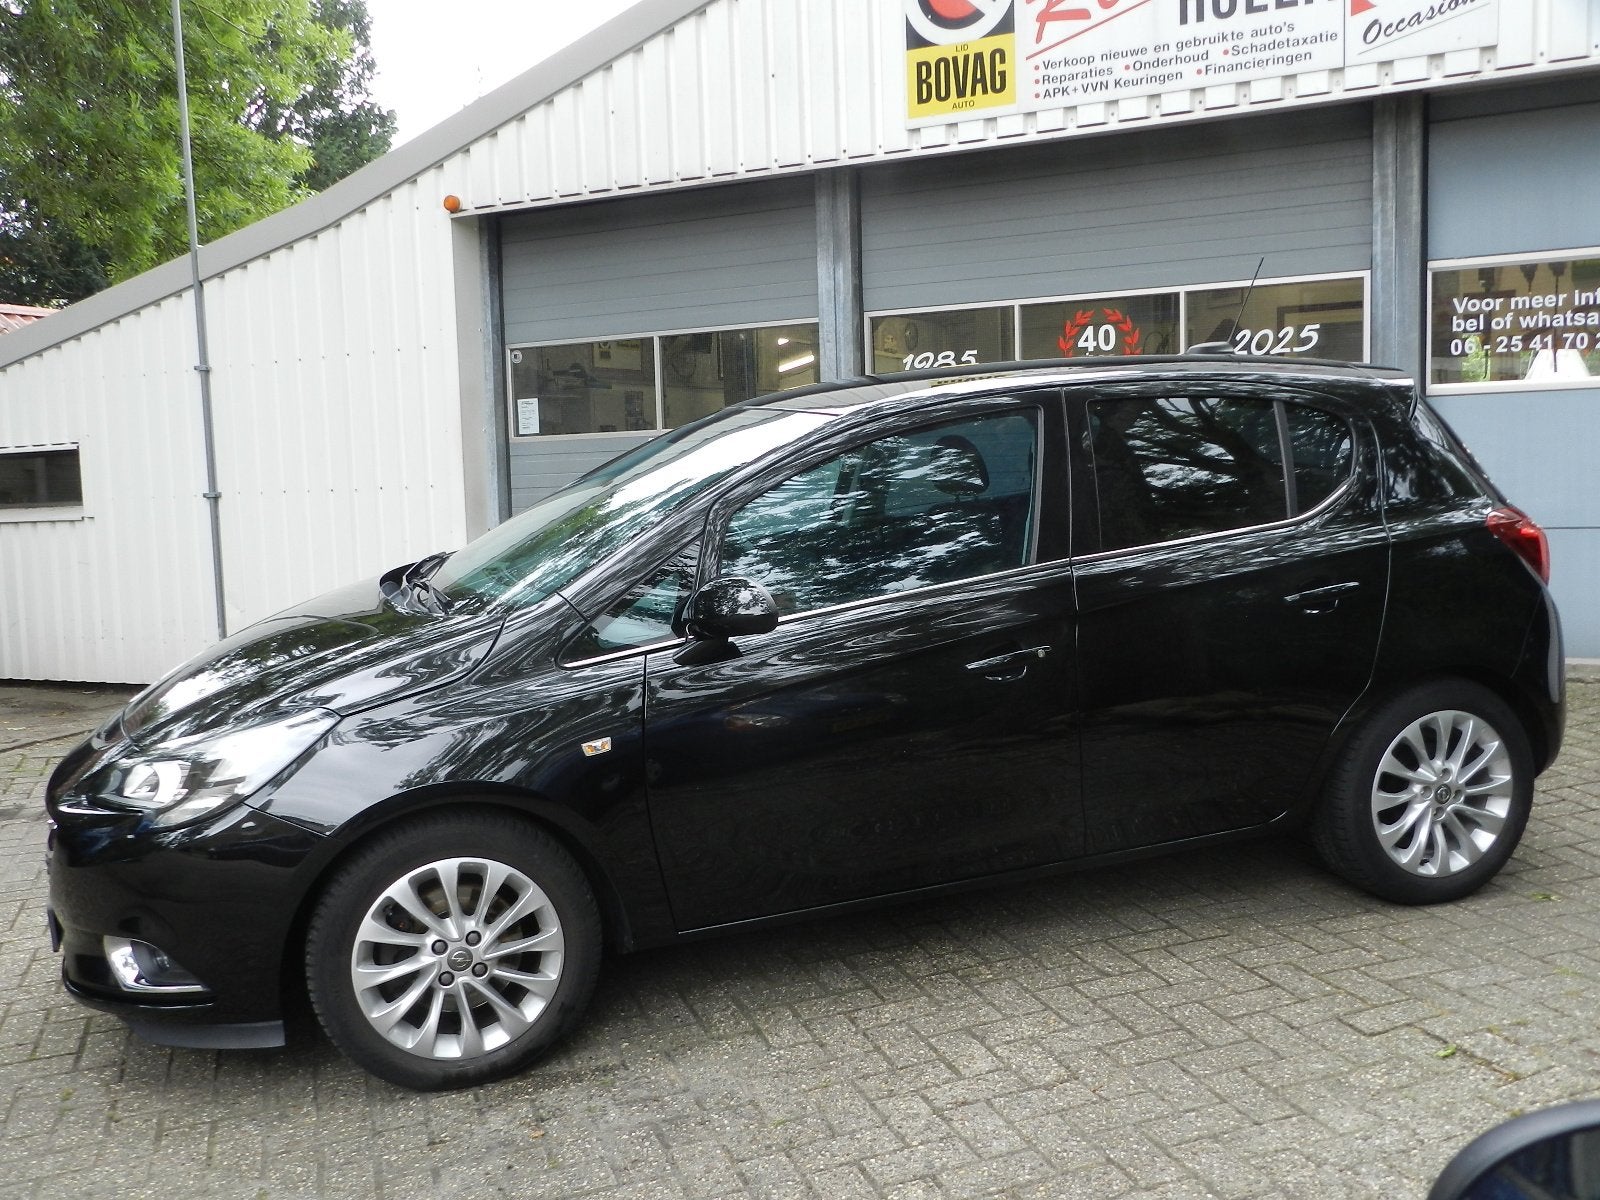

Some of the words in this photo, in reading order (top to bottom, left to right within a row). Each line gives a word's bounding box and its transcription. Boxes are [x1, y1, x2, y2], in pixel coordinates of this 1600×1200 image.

[955, 44, 969, 53] LID
[1042, 66, 1114, 86] Reparaties
[1133, 50, 1209, 71] Onderhoud
[1231, 31, 1338, 56] Schadetaxatie
[1043, 53, 1095, 70] Verkoop
[1100, 46, 1148, 61] nieuwe
[1153, 43, 1170, 54] en
[1176, 31, 1244, 52] gebruikte
[1250, 22, 1295, 38] auto's
[916, 47, 1007, 105] BOVAG
[1114, 70, 1183, 89] Keuringen
[1205, 51, 1312, 76] Financieringen
[951, 100, 975, 110] AUTO
[1453, 296, 1504, 314] Voor
[1510, 294, 1567, 310] meer
[1452, 314, 1484, 332] bel
[1491, 312, 1513, 330] of
[1519, 310, 1599, 329] whatsa
[1077, 324, 1116, 351] 40
[1234, 323, 1321, 355] 2025
[1450, 338, 1475, 355] 06
[1496, 335, 1523, 353] 25
[1529, 334, 1553, 351] 41
[1563, 332, 1589, 350] 70
